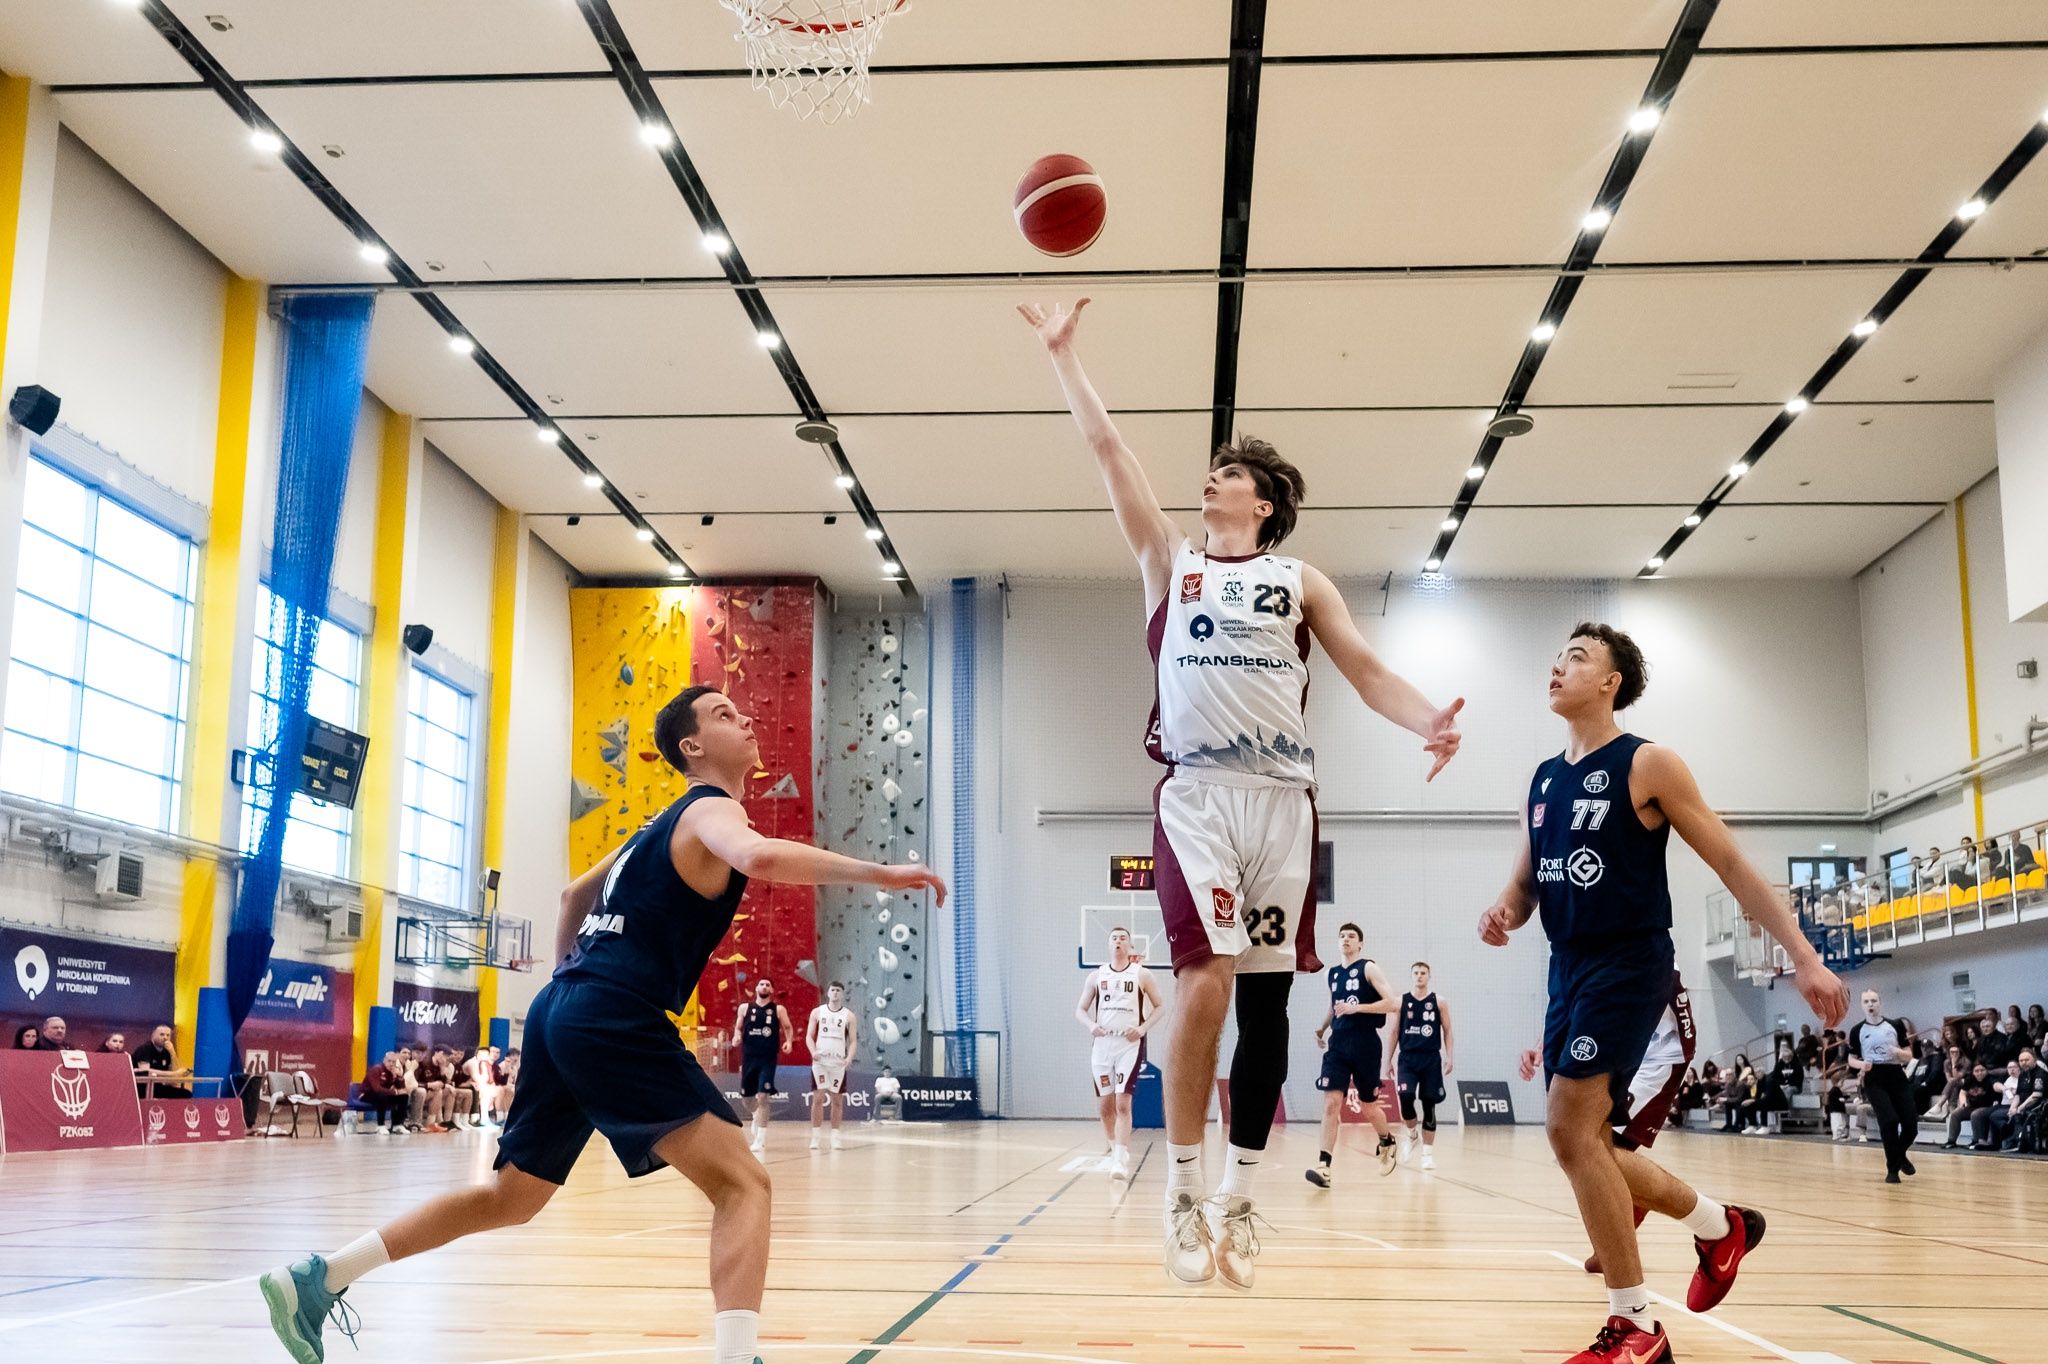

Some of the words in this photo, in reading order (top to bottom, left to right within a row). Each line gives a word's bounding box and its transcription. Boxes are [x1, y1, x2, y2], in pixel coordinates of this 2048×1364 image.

[1253, 583, 1291, 617] 23
[1570, 799, 1611, 831] 77
[1540, 857, 1564, 871] PORT
[1122, 872, 1145, 887] 21
[1243, 906, 1286, 946] 23
[57, 956, 107, 971] UNIWERSYTET
[56, 969, 93, 982] MIKOŁAJA
[93, 973, 131, 985] KOPERNIKA
[56, 982, 65, 992] W
[65, 983, 98, 995] TORUNIU
[1123, 980, 1134, 993] 10
[833, 1078, 840, 1088] 2
[901, 1089, 972, 1101] TORIMPEX
[1478, 1099, 1509, 1113] TRB
